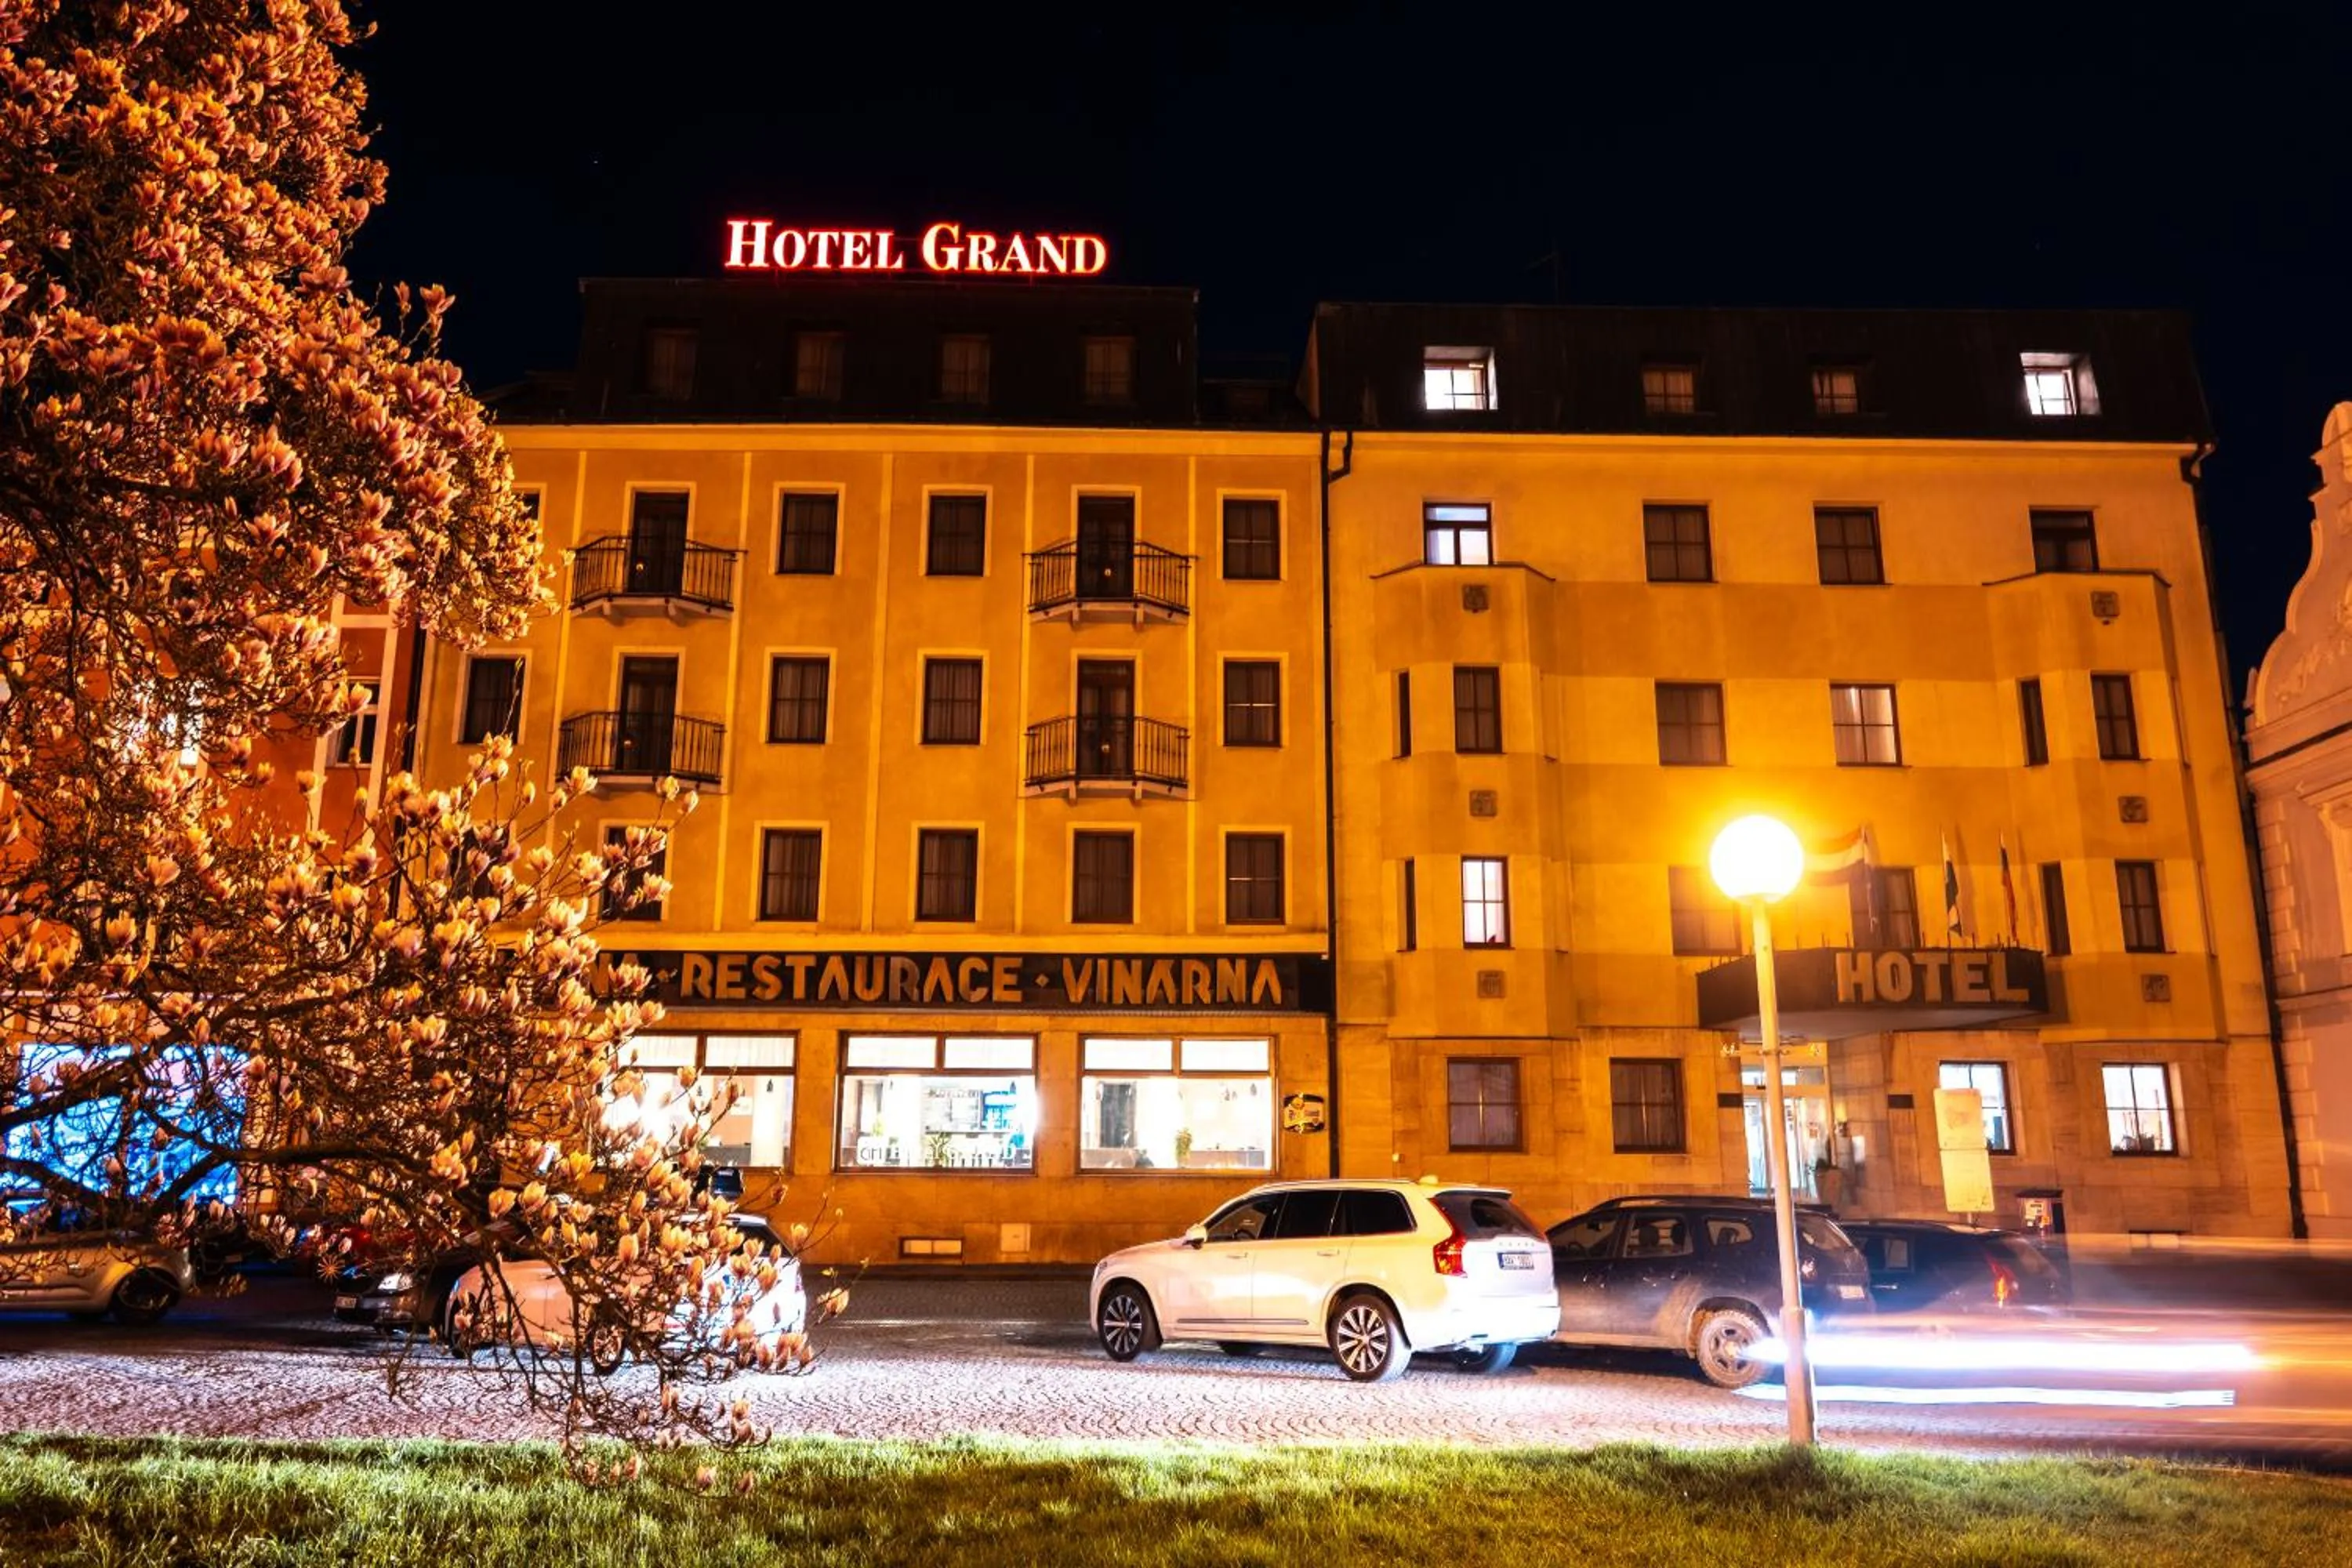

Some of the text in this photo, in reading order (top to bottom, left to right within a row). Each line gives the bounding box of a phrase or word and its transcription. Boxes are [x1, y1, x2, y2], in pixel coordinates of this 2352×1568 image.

[724, 220, 1107, 274] HOTEL GRAND
[681, 953, 1023, 1004] RESTAURACE
[1835, 951, 2030, 1004] HOTEL
